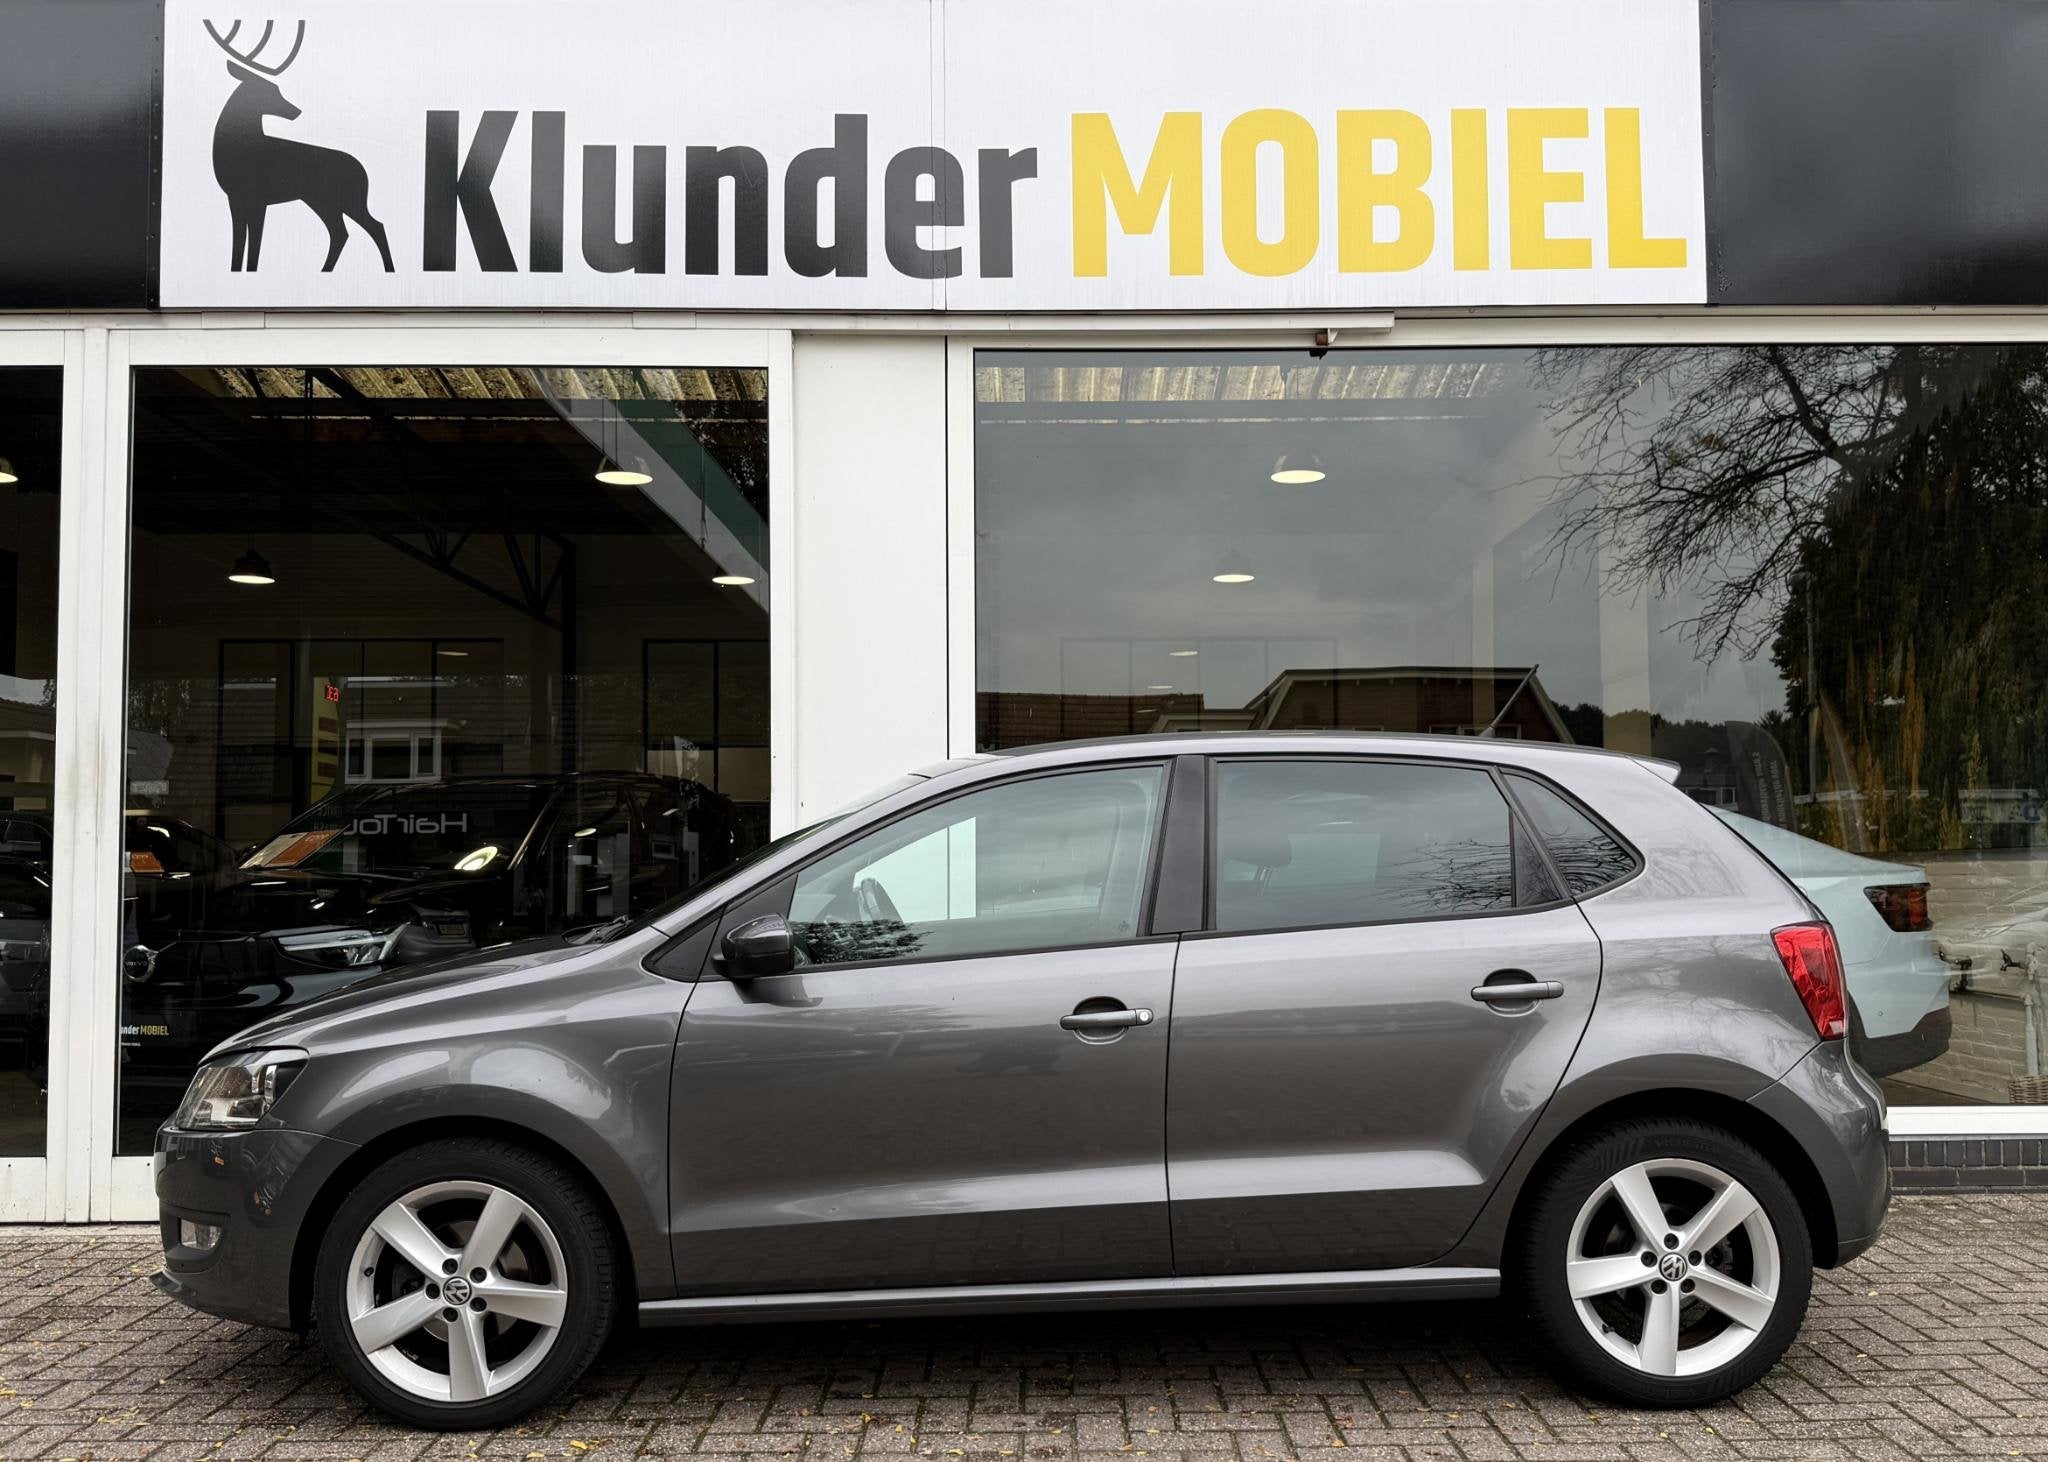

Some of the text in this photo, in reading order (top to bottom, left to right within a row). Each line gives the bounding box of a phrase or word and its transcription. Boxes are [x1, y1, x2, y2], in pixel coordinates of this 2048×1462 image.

[422, 107, 1689, 280] Klunder MOBIEL
[140, 1025, 169, 1036] MOBIEL
